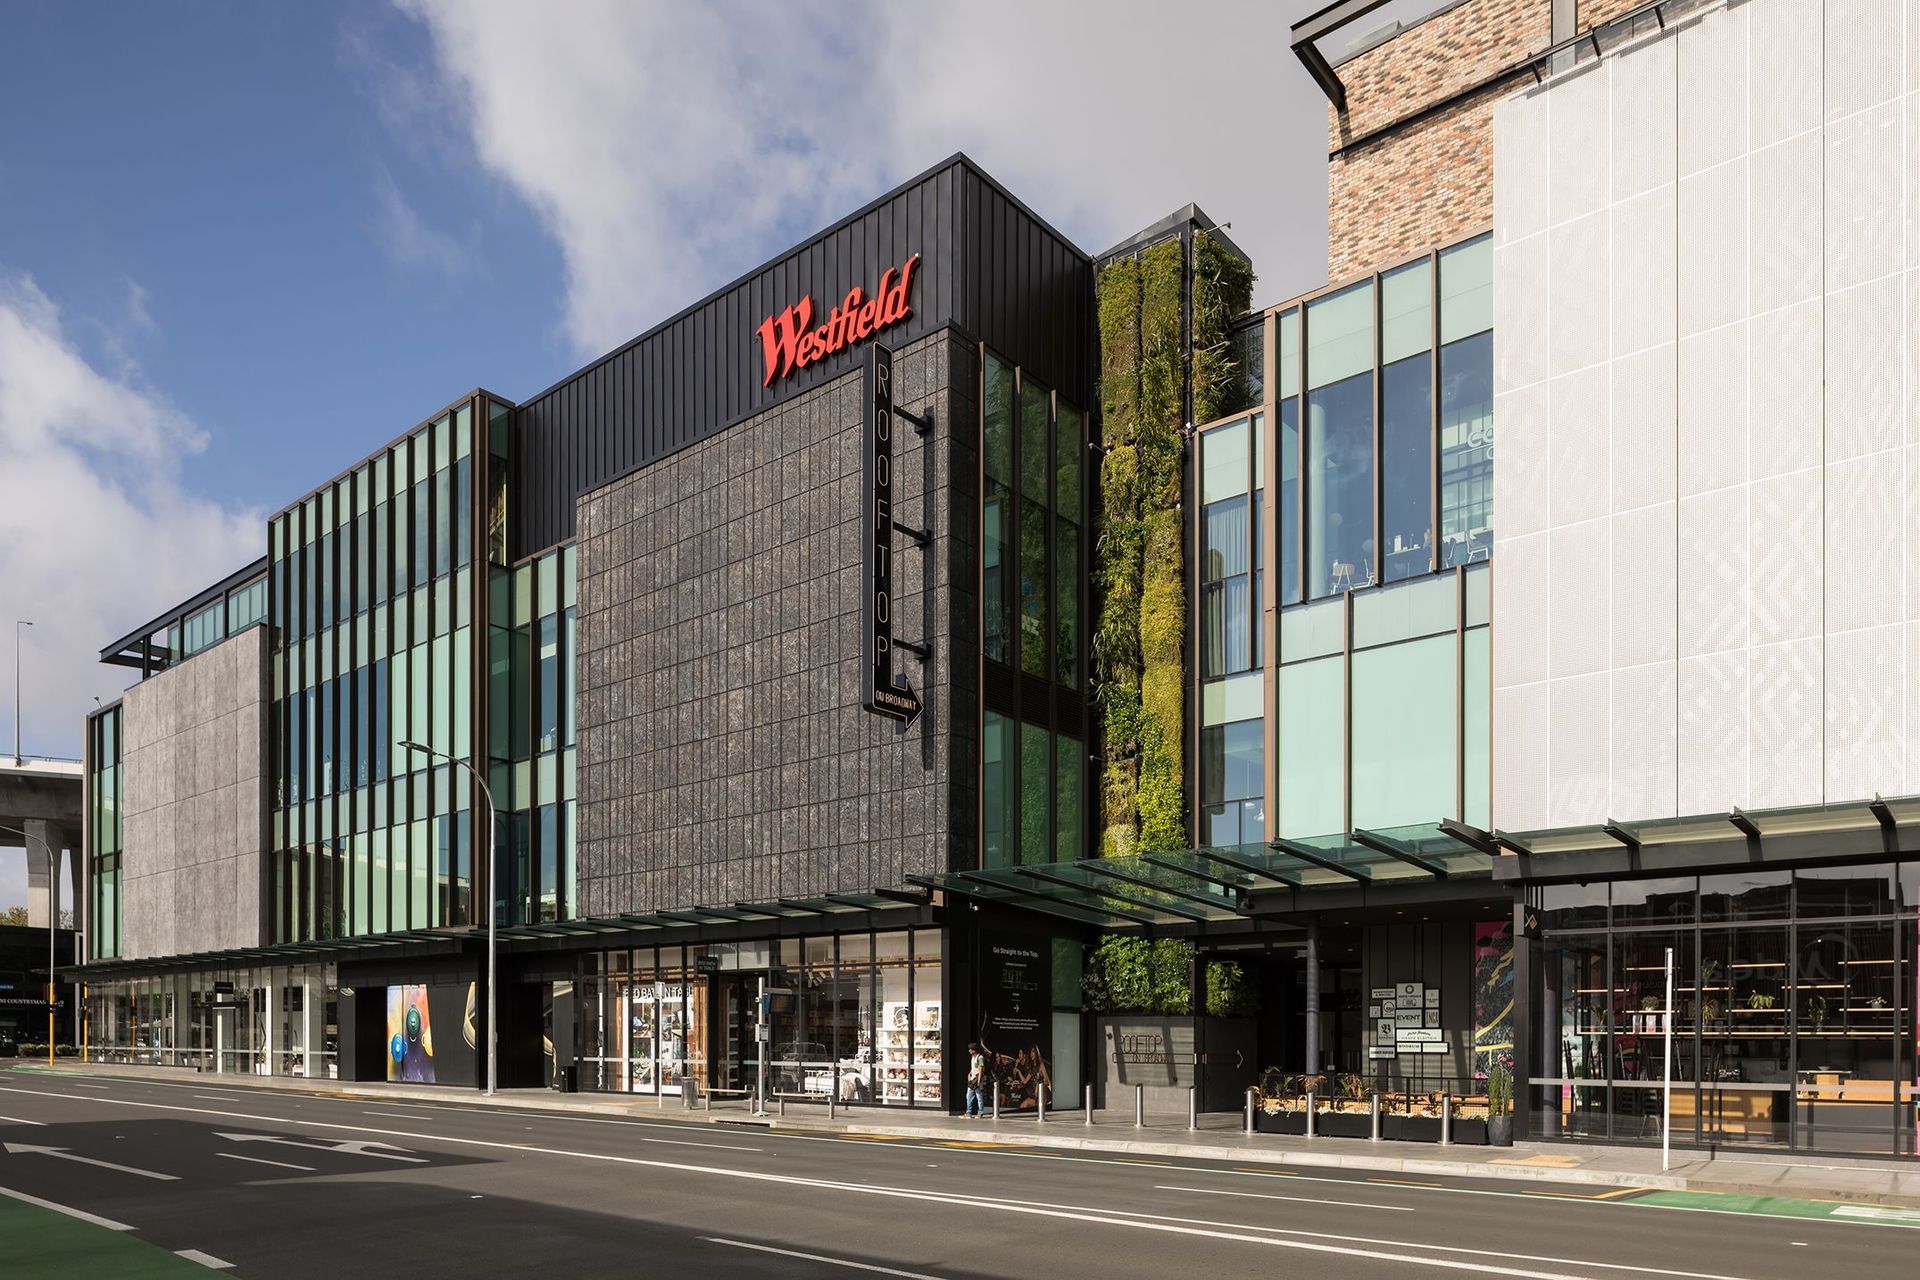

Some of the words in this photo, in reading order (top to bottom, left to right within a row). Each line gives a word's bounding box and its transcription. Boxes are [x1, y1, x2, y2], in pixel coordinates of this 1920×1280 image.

[755, 253, 919, 388] Westfield
[877, 363, 889, 668] ROOFTOP
[875, 690, 885, 702] ON
[885, 692, 917, 710] BROADWAY
[993, 946, 1000, 954] Go
[623, 988, 641, 999] BD
[672, 985, 694, 998] TAL
